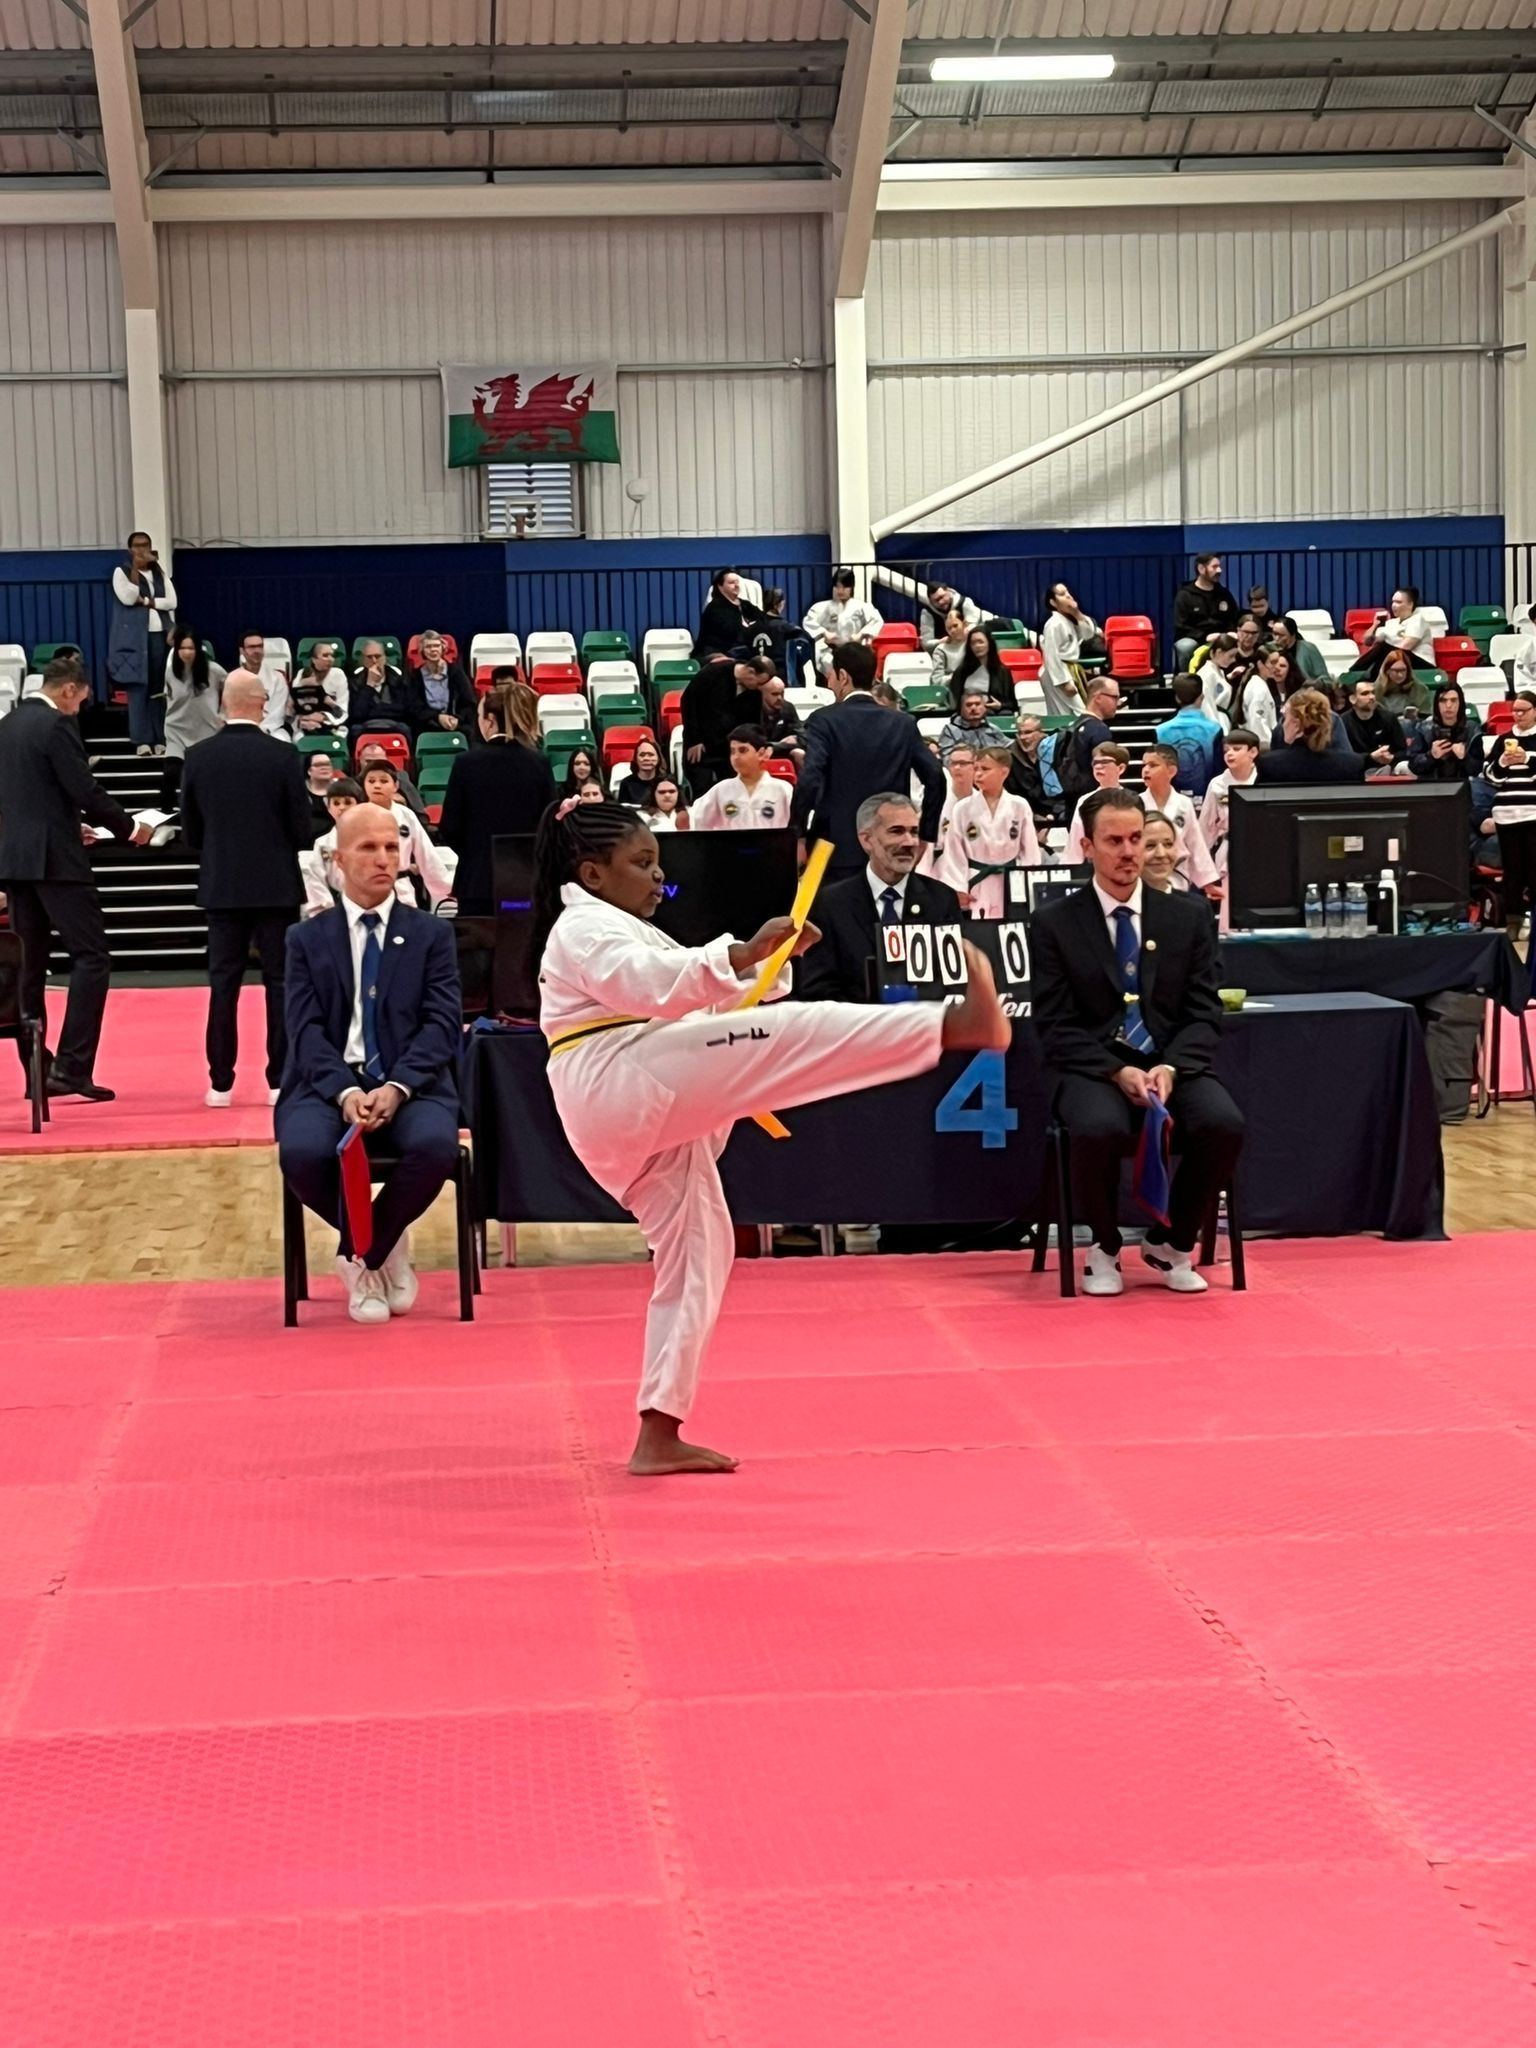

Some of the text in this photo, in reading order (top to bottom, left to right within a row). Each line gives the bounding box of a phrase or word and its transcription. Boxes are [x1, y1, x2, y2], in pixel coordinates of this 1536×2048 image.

[888, 930, 1026, 980] 0 0 0 0
[935, 1049, 1018, 1149] 4
